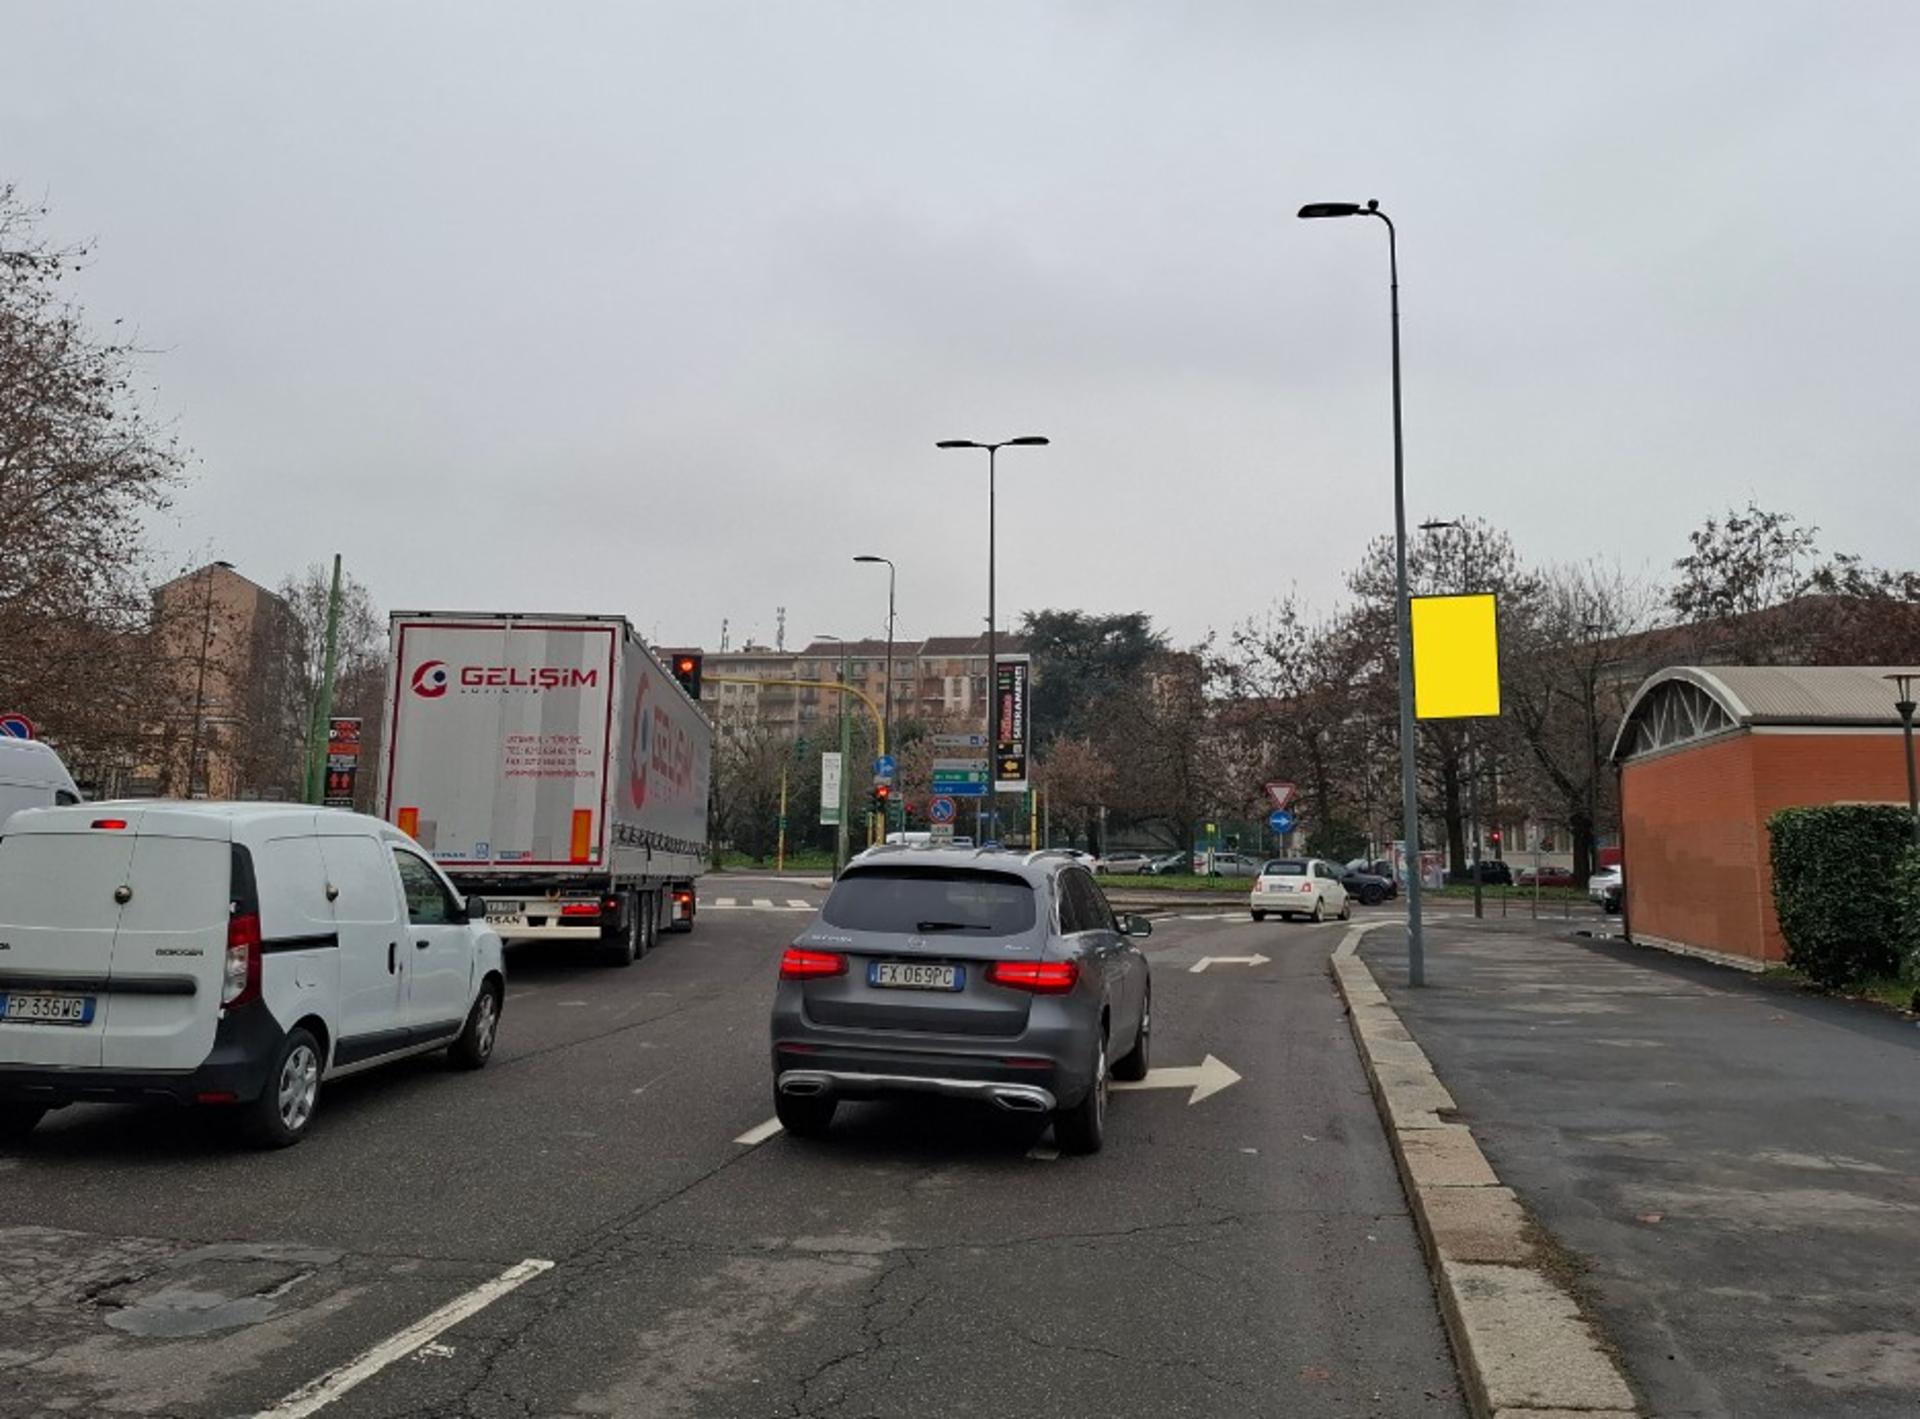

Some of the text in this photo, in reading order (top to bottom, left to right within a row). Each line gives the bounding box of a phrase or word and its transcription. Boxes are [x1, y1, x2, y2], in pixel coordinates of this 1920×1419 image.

[879, 965, 953, 985] FX 069PC
[8, 998, 28, 1016] FP
